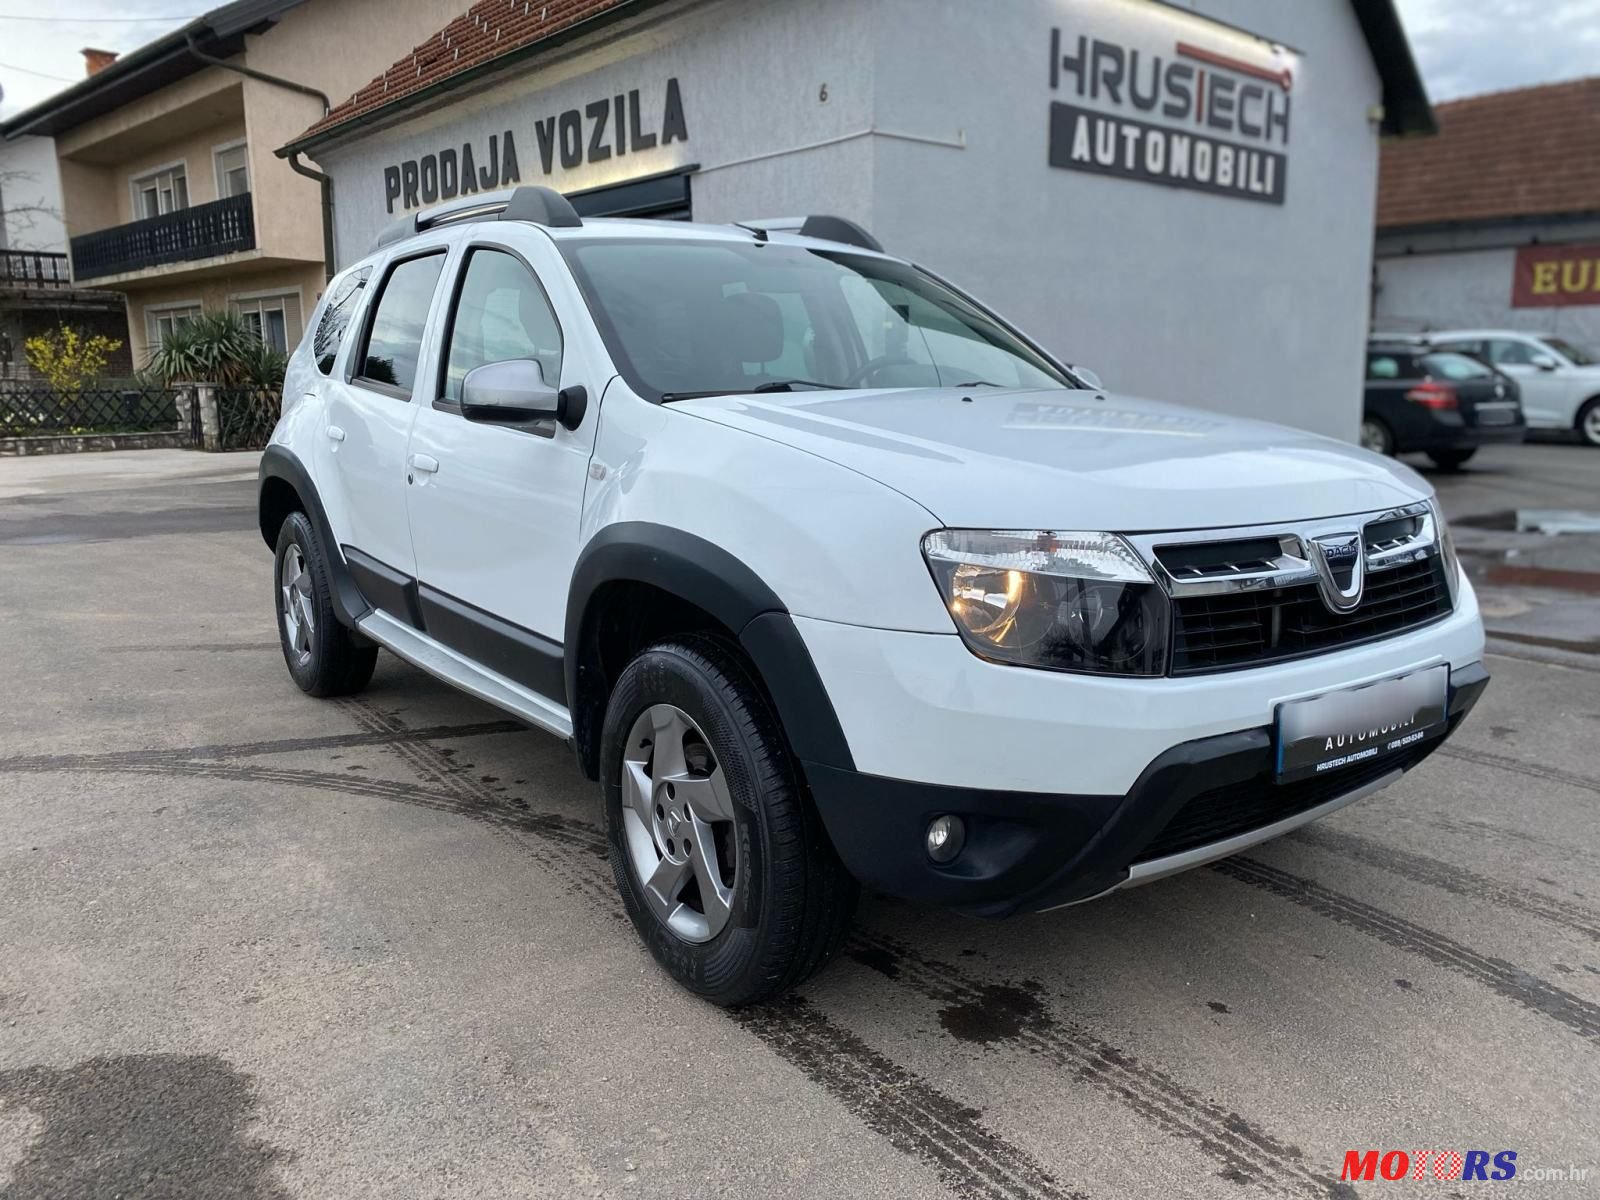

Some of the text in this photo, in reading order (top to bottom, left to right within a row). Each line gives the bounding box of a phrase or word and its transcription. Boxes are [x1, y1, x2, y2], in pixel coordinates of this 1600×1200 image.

[819, 82, 828, 102] 6
[1049, 27, 1292, 146] HRUSTECH
[383, 77, 689, 214] PRODAJA VOZILA
[1071, 114, 1275, 195] AUTOMOBILI
